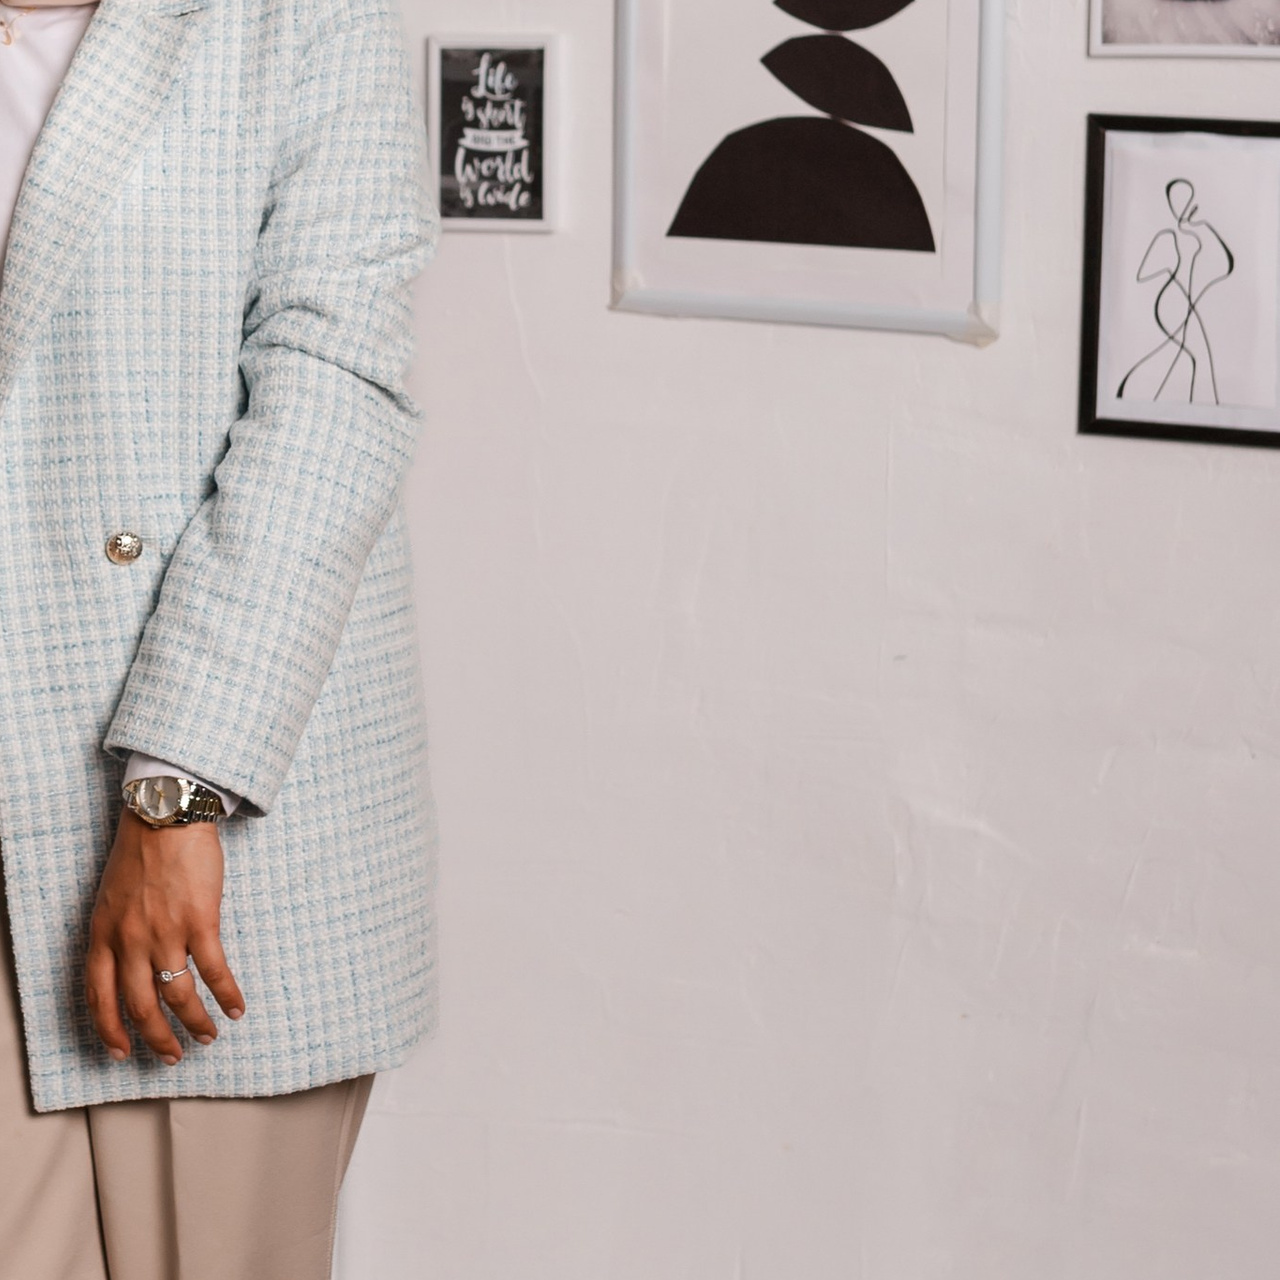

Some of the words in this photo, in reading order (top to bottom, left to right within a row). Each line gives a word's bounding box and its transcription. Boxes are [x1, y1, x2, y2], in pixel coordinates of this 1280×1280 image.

[470, 52, 518, 101] Life
[461, 95, 475, 122] is
[476, 98, 527, 130] short
[459, 183, 474, 208] is
